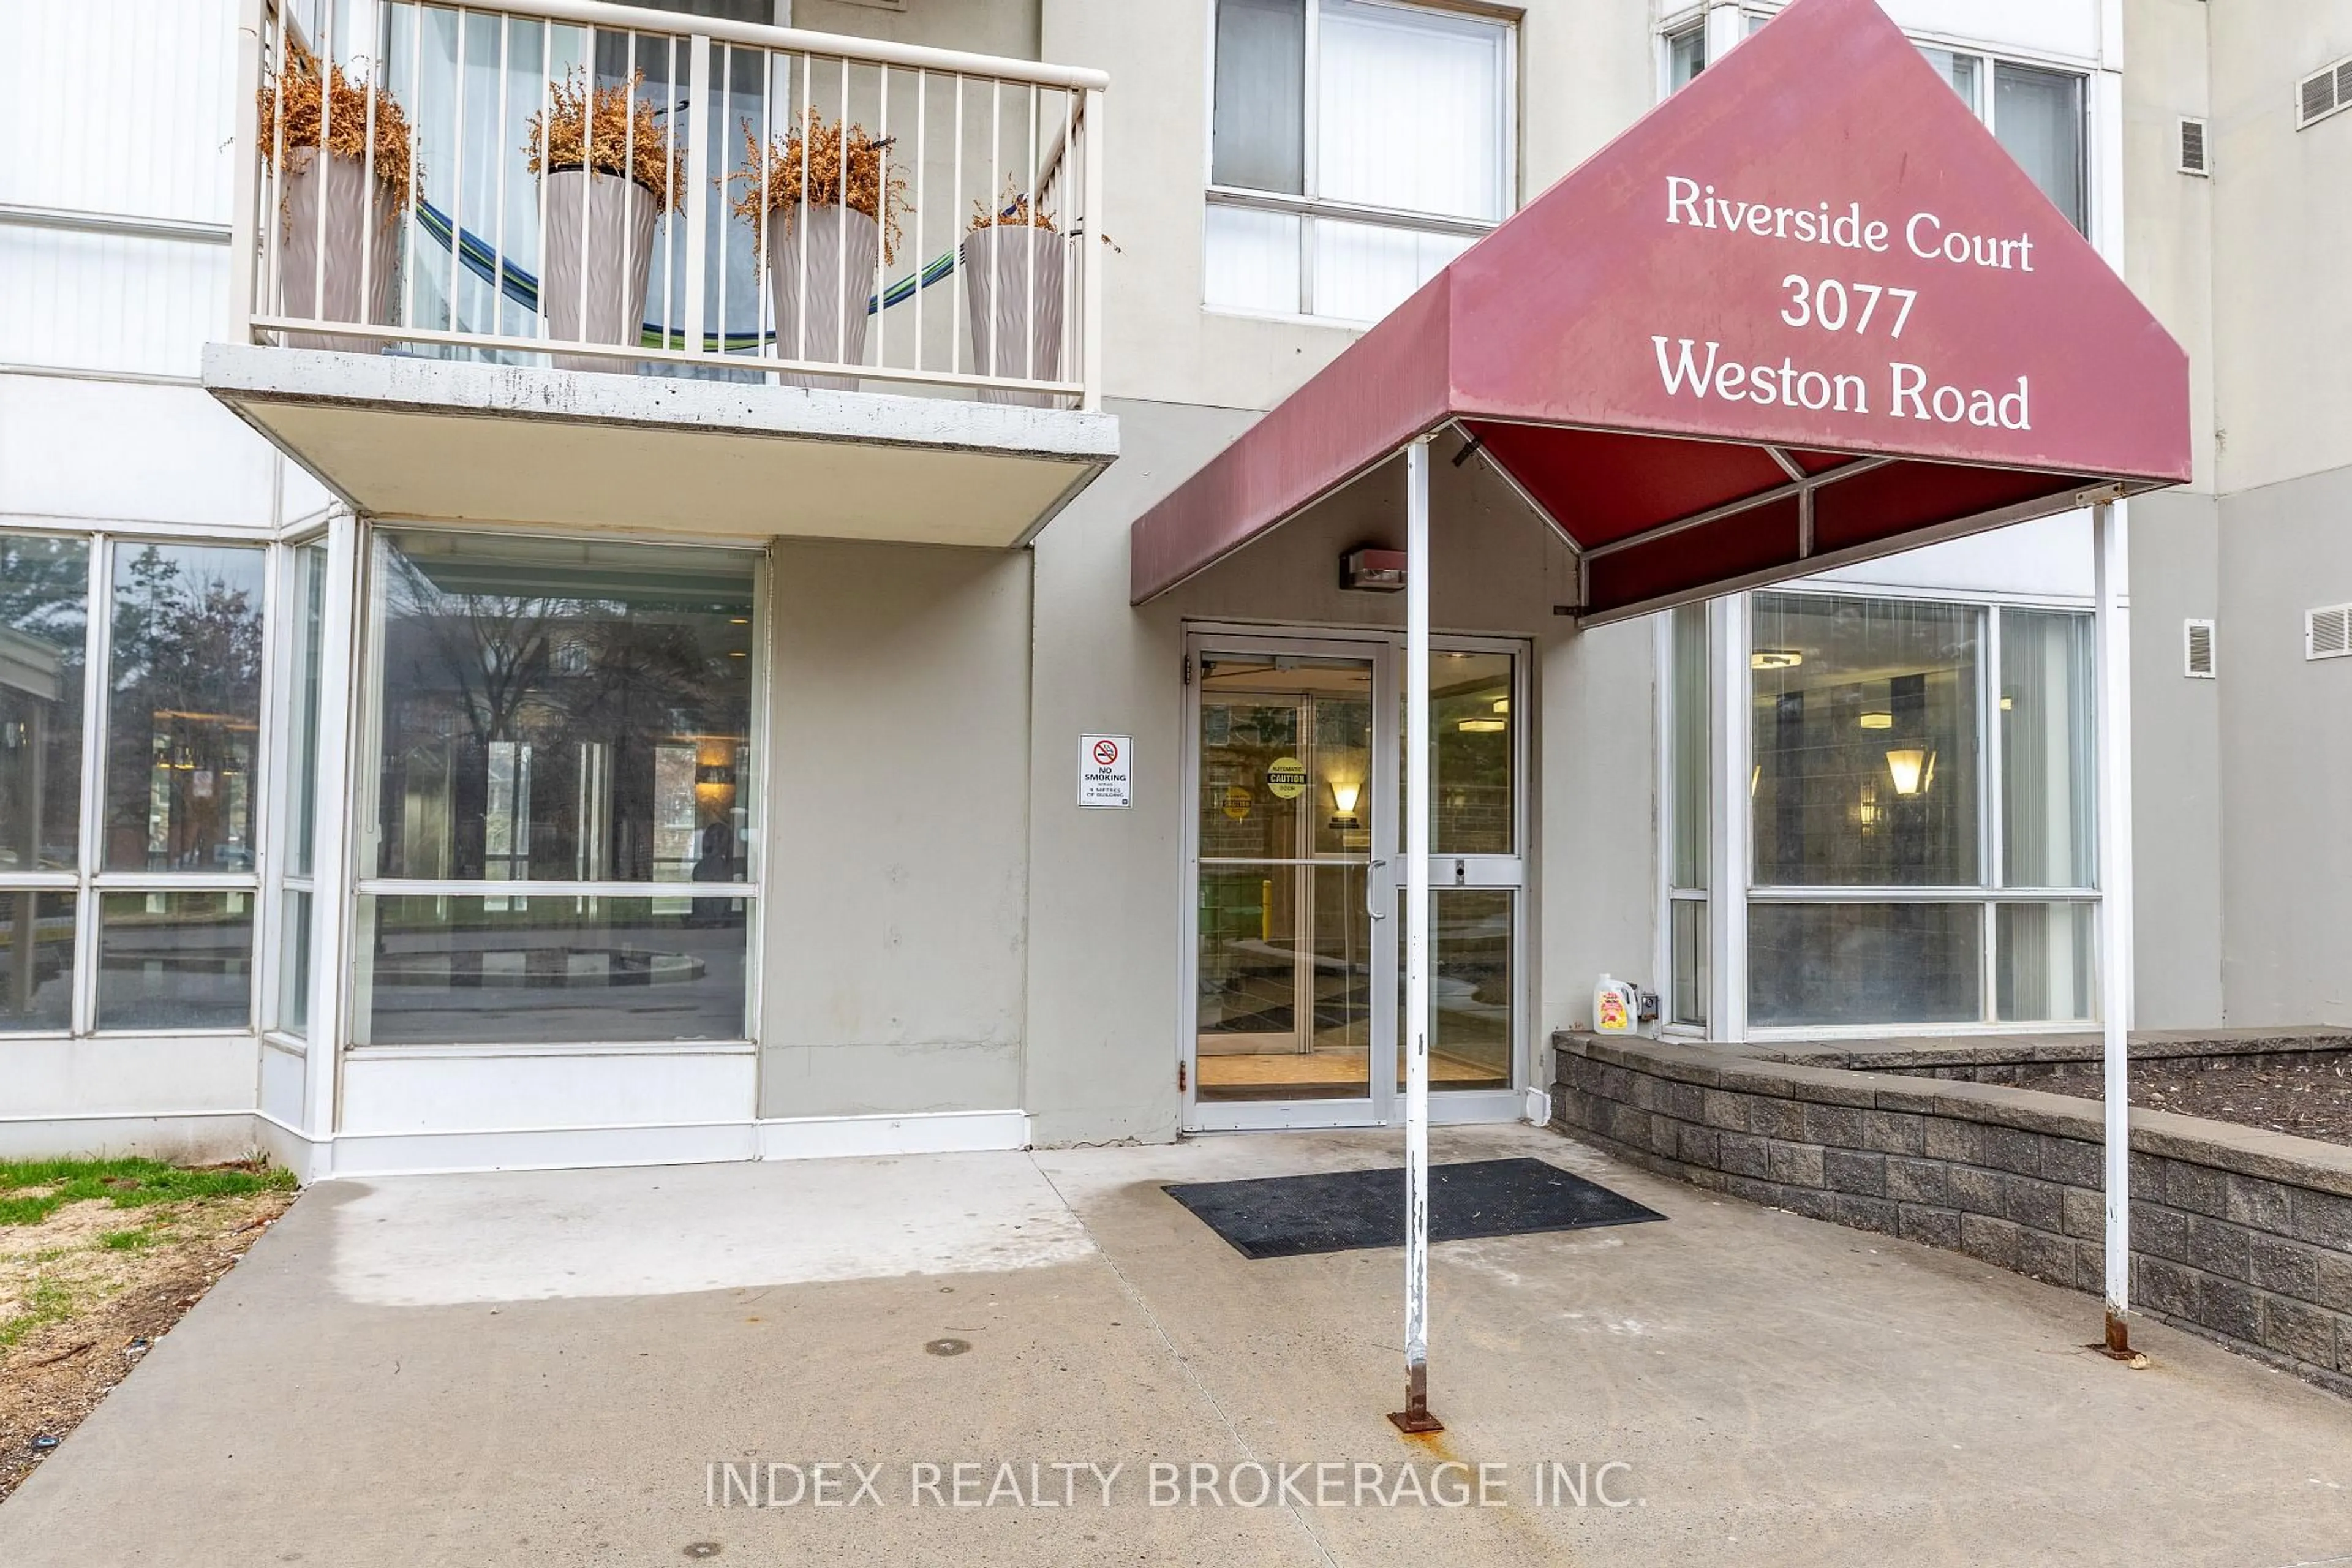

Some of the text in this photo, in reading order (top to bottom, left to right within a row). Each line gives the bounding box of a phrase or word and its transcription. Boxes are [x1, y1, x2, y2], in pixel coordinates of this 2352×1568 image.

[1665, 176, 2034, 271] Riverside Court
[1781, 274, 1917, 339] 3077
[1651, 335, 2031, 430] Weston Road
[1270, 774, 1305, 783] CAUTION
